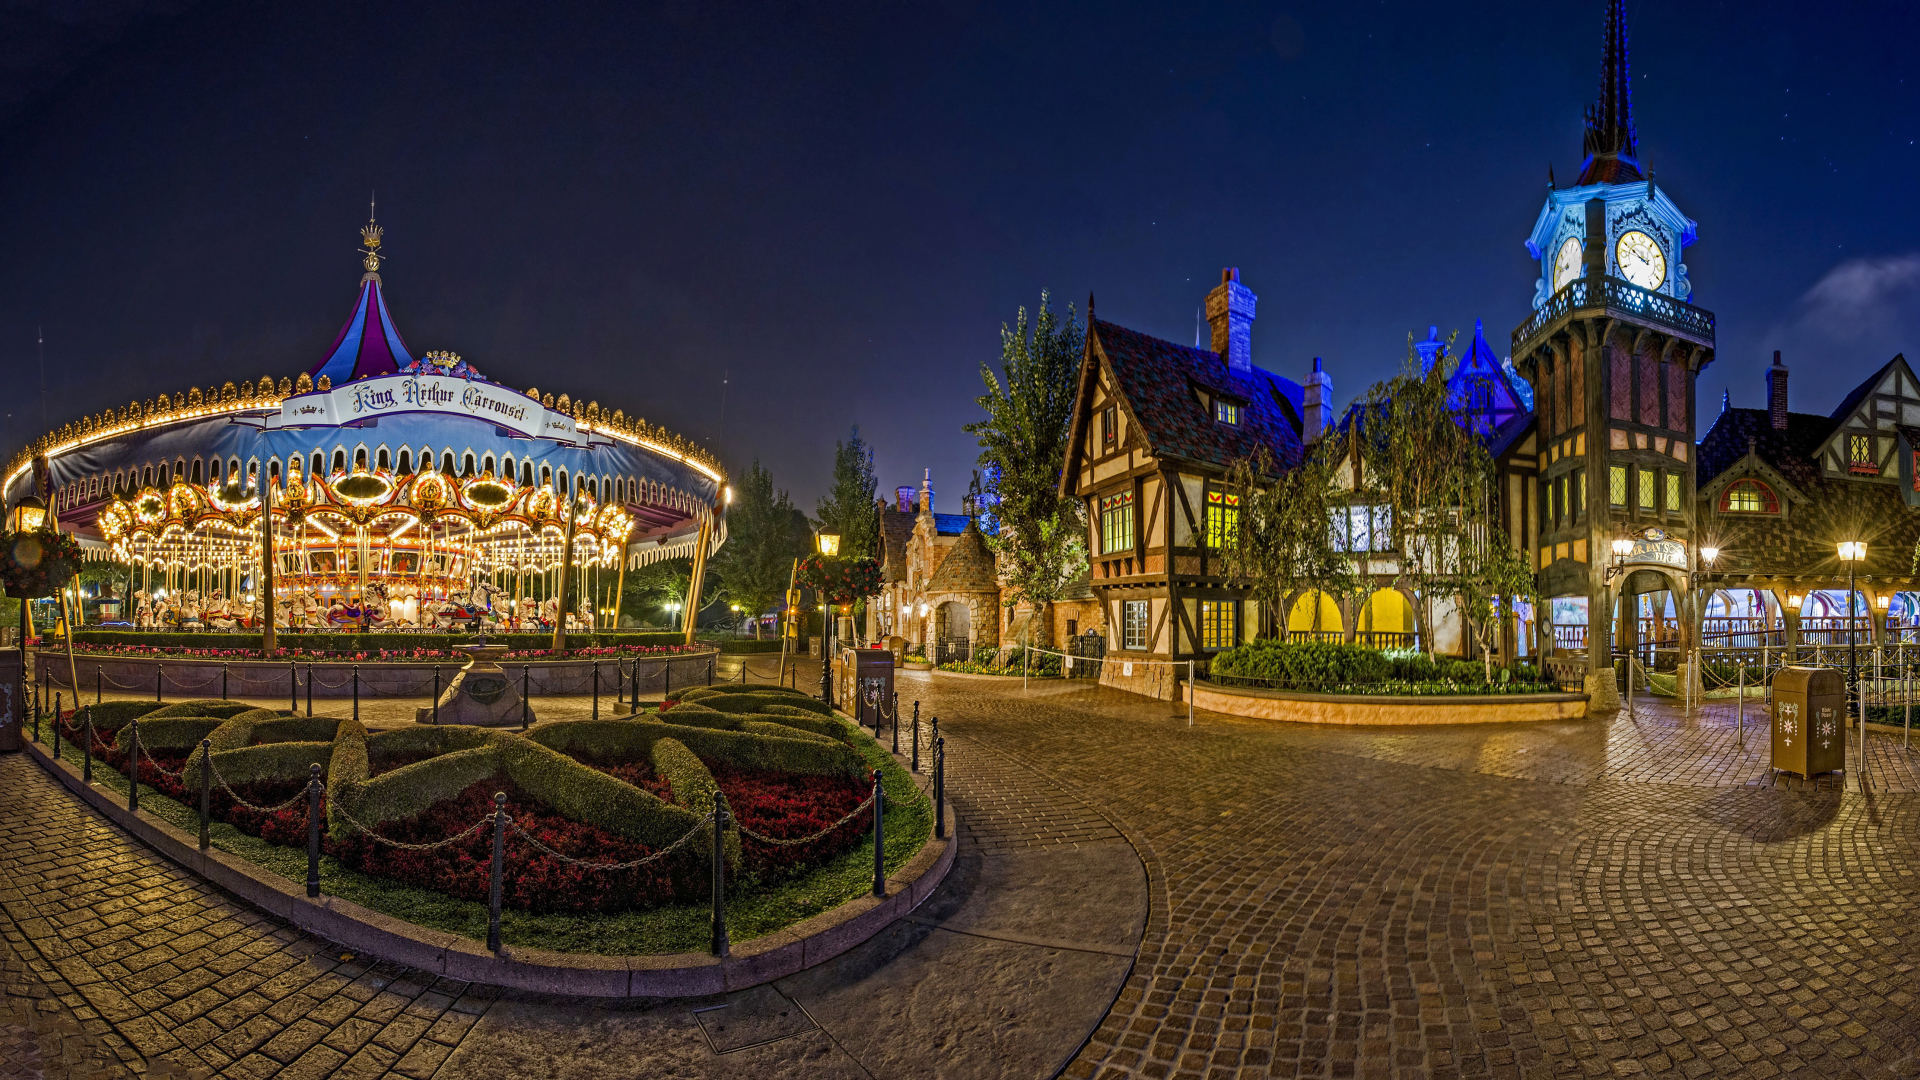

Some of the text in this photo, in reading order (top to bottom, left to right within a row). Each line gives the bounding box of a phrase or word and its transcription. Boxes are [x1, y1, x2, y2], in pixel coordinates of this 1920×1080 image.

[348, 379, 530, 421] King Arthur Carrousel
